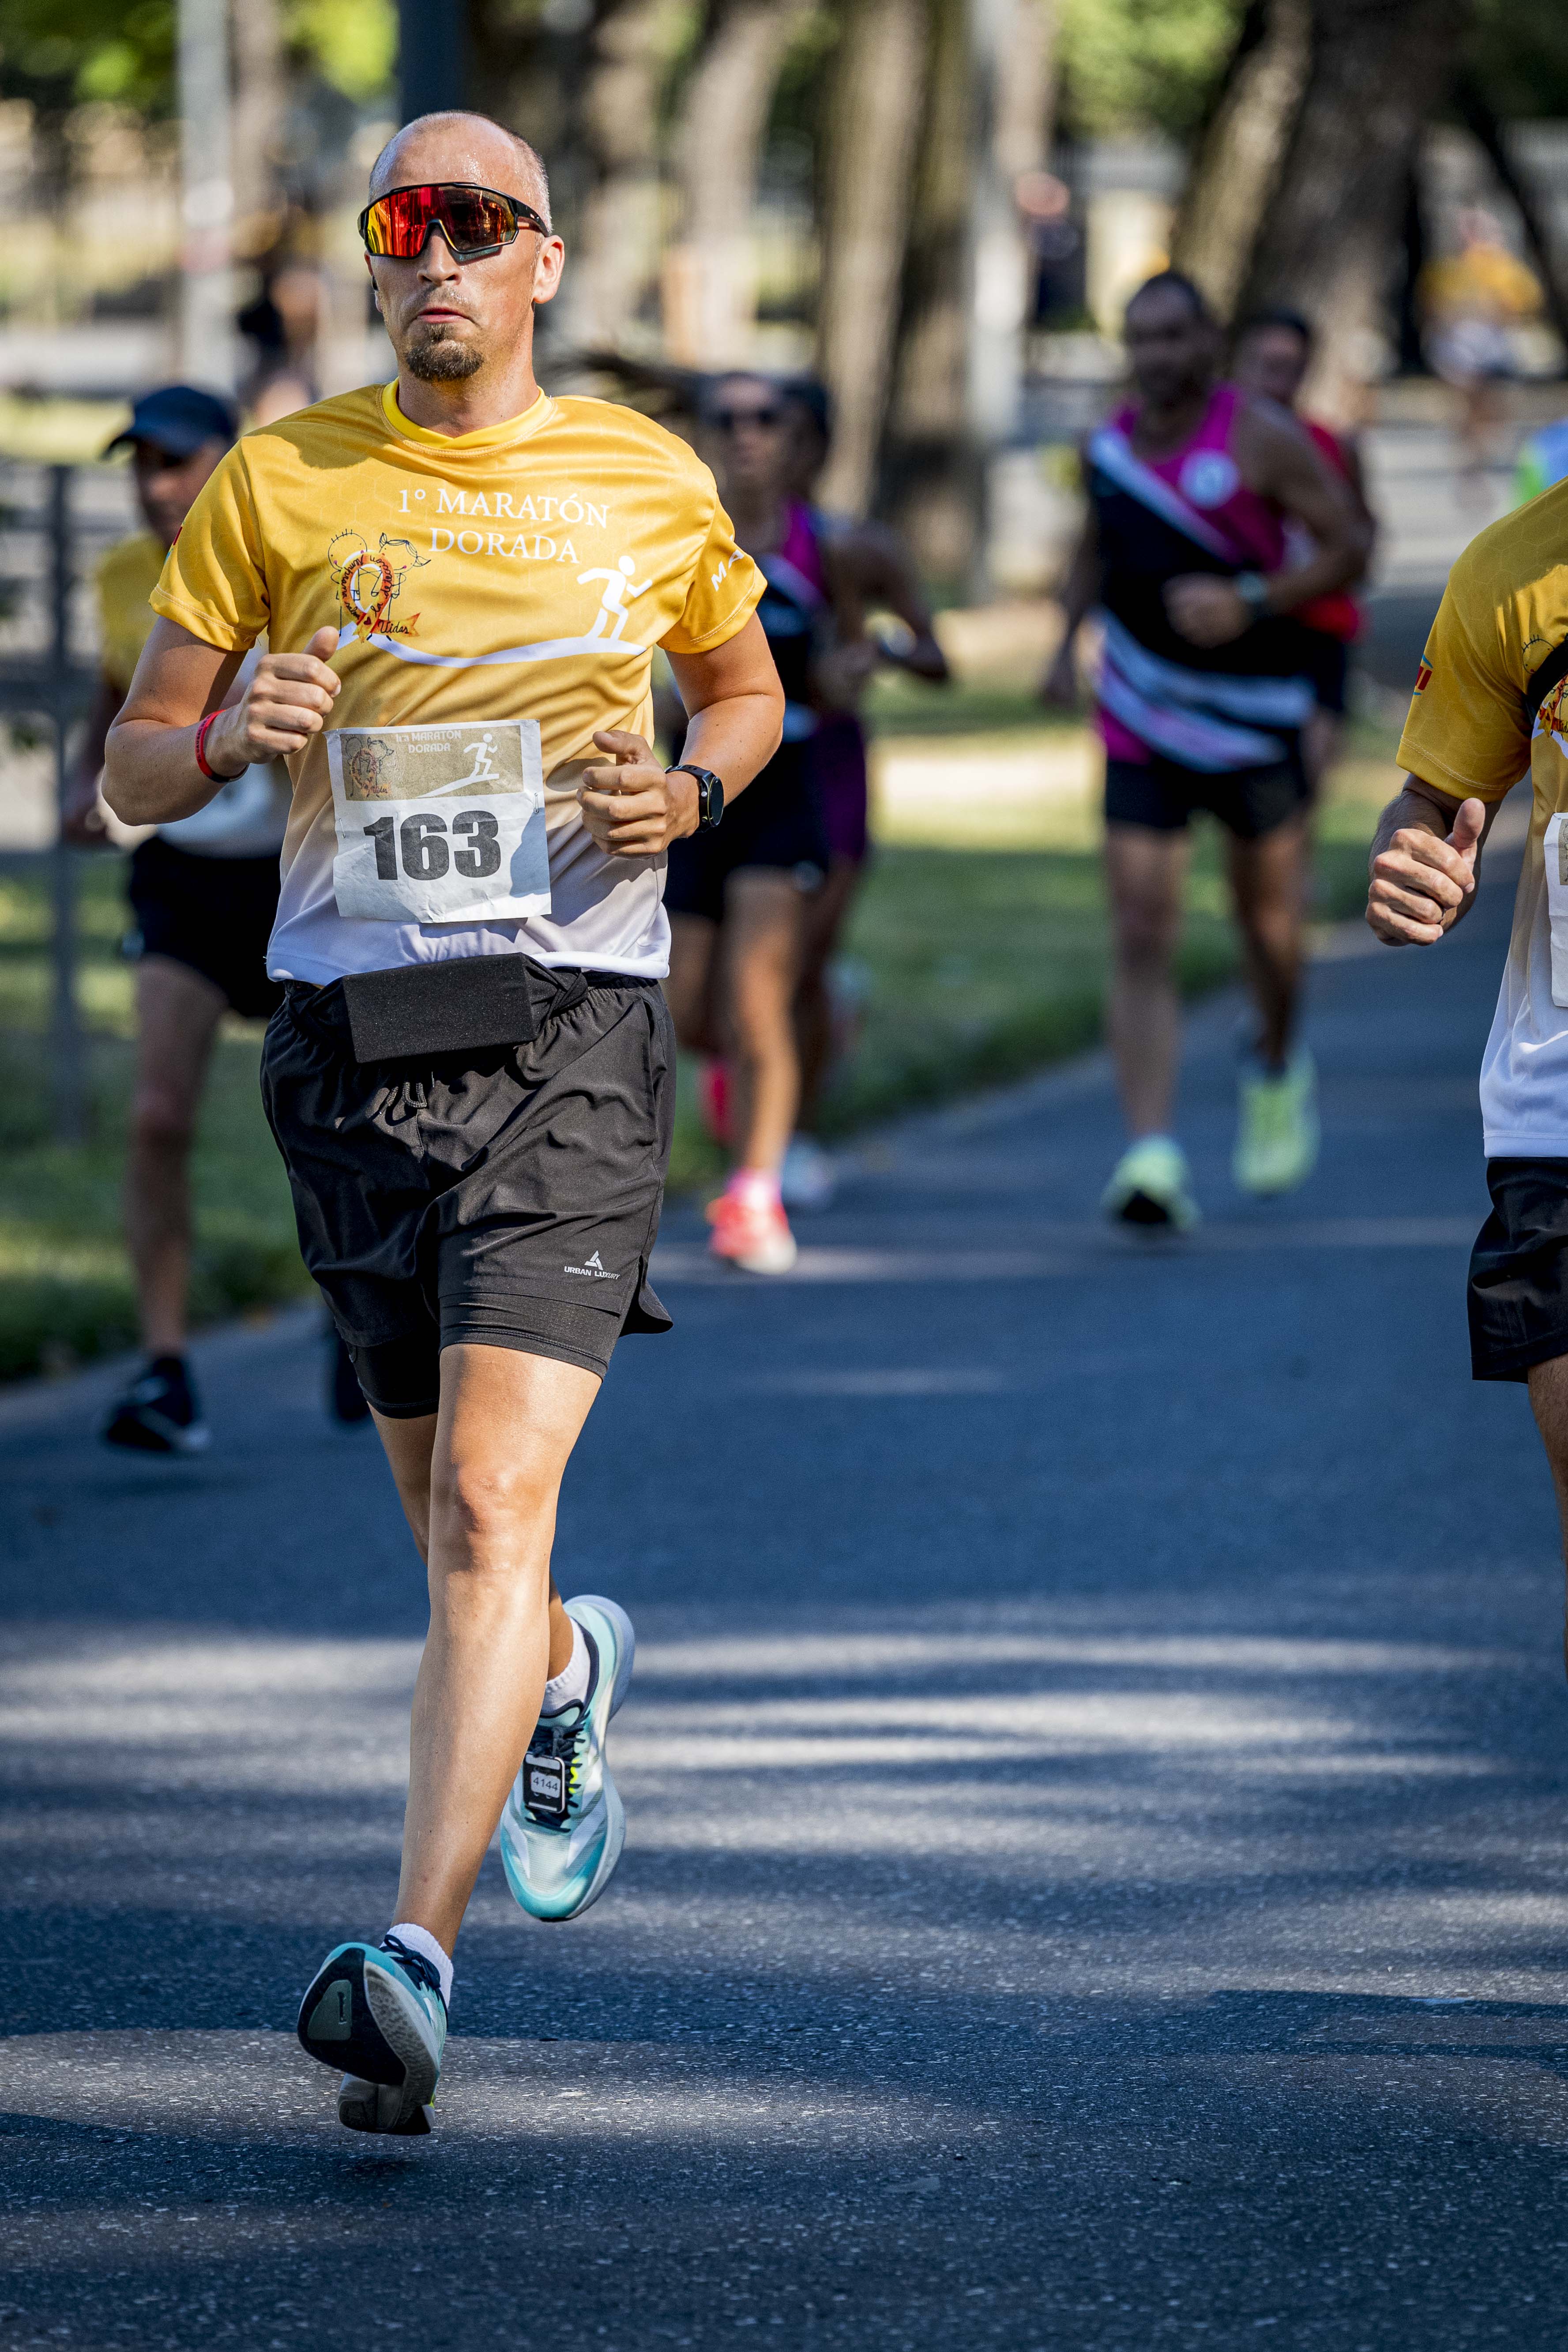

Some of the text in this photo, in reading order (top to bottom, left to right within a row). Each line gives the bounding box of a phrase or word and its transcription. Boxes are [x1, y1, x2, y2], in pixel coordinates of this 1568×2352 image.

[436, 488, 609, 529] MARATÓN
[429, 527, 579, 564] DORADA
[408, 743, 451, 753] DORADA
[363, 811, 501, 880] 163
[564, 1266, 620, 1280] URBAN LUXURY
[534, 1777, 558, 1791] 4144
